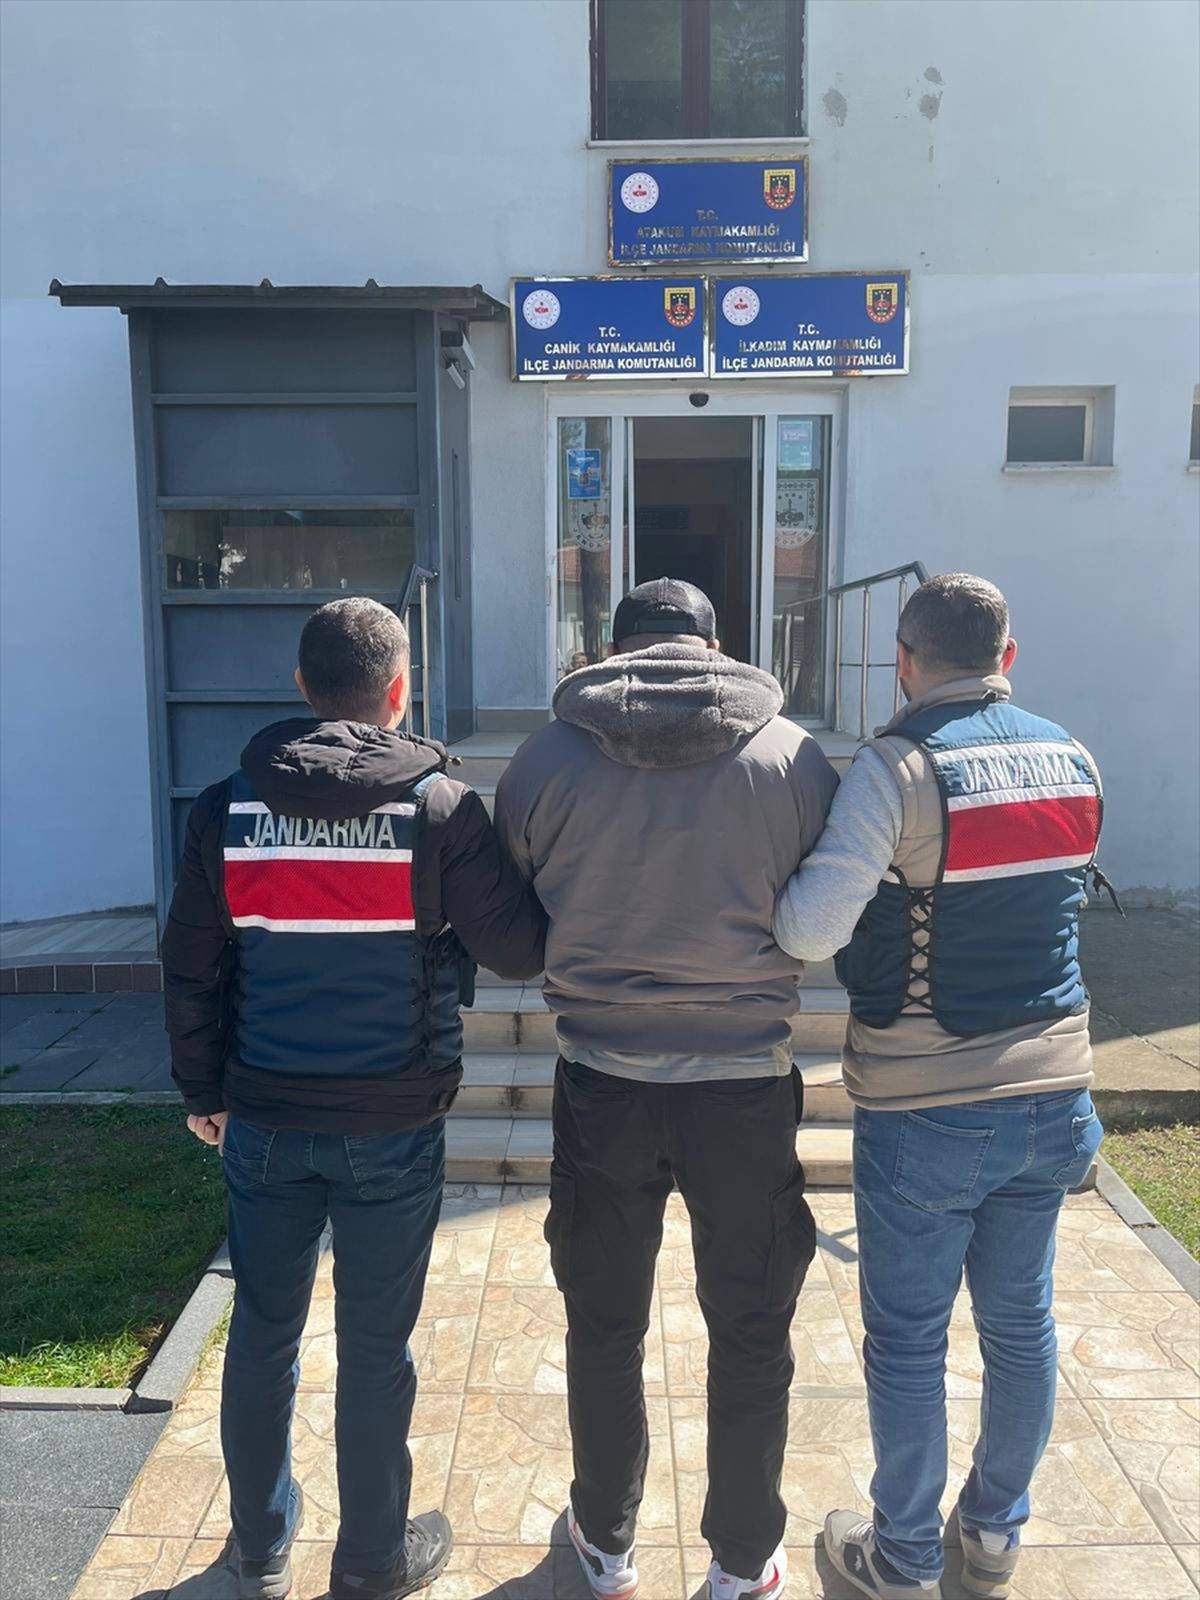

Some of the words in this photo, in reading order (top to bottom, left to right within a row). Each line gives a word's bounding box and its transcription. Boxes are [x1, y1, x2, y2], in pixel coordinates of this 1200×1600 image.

[696, 210, 719, 221] T.C.
[598, 326, 621, 338] T.C.
[798, 324, 820, 335] T.C.
[544, 340, 581, 354] CANİK
[587, 339, 676, 353] KAYMAKAMLIĞI
[738, 339, 787, 352] İLKADIM
[524, 357, 549, 373] İLÇE
[552, 358, 615, 370] JANDARMA
[617, 355, 697, 370] KOMUTANLIĞI
[722, 356, 748, 371] İLÇE
[751, 355, 814, 368] JANDARMA
[961, 753, 1081, 794] JANDARMA
[244, 813, 397, 848] JANDARMA
